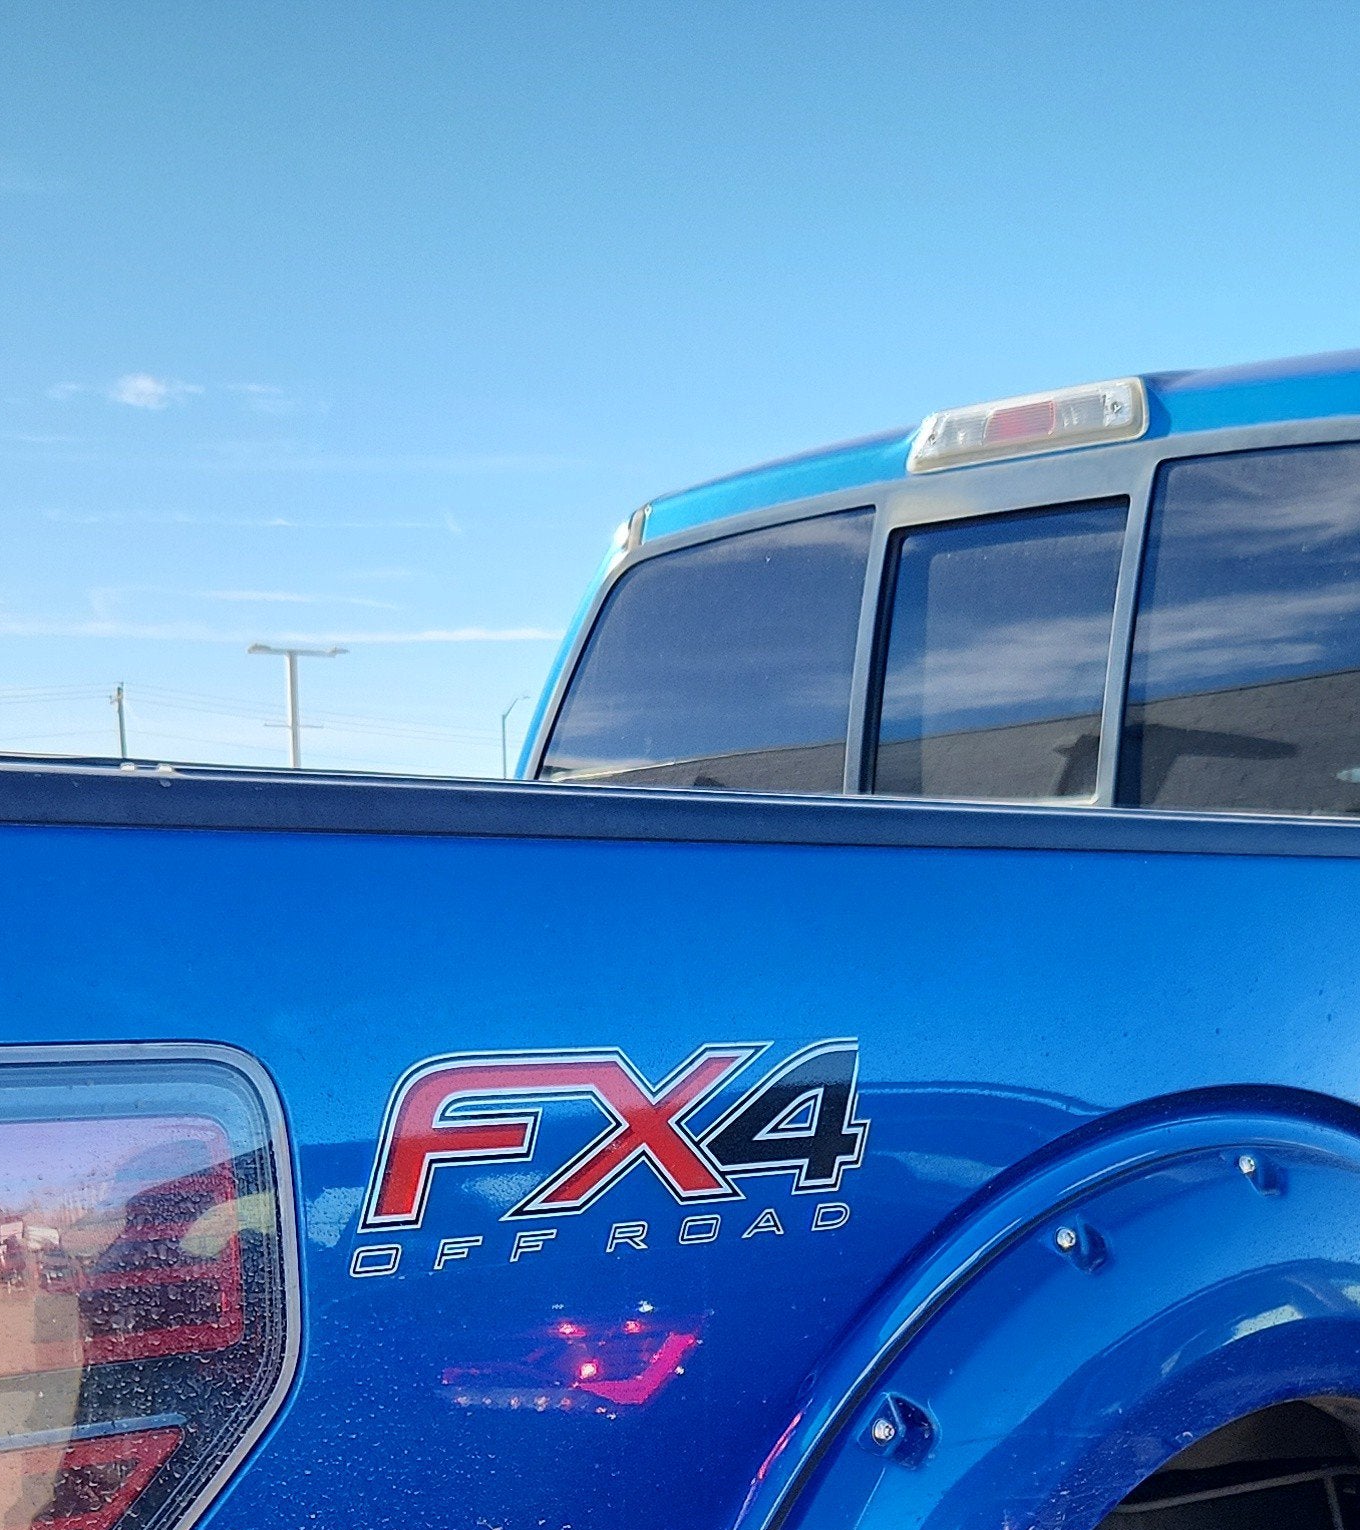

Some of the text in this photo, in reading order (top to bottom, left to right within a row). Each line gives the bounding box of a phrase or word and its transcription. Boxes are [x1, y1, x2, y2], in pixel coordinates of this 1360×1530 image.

[358, 1037, 870, 1233] FX4
[349, 1202, 850, 1278] OFF ROAD
